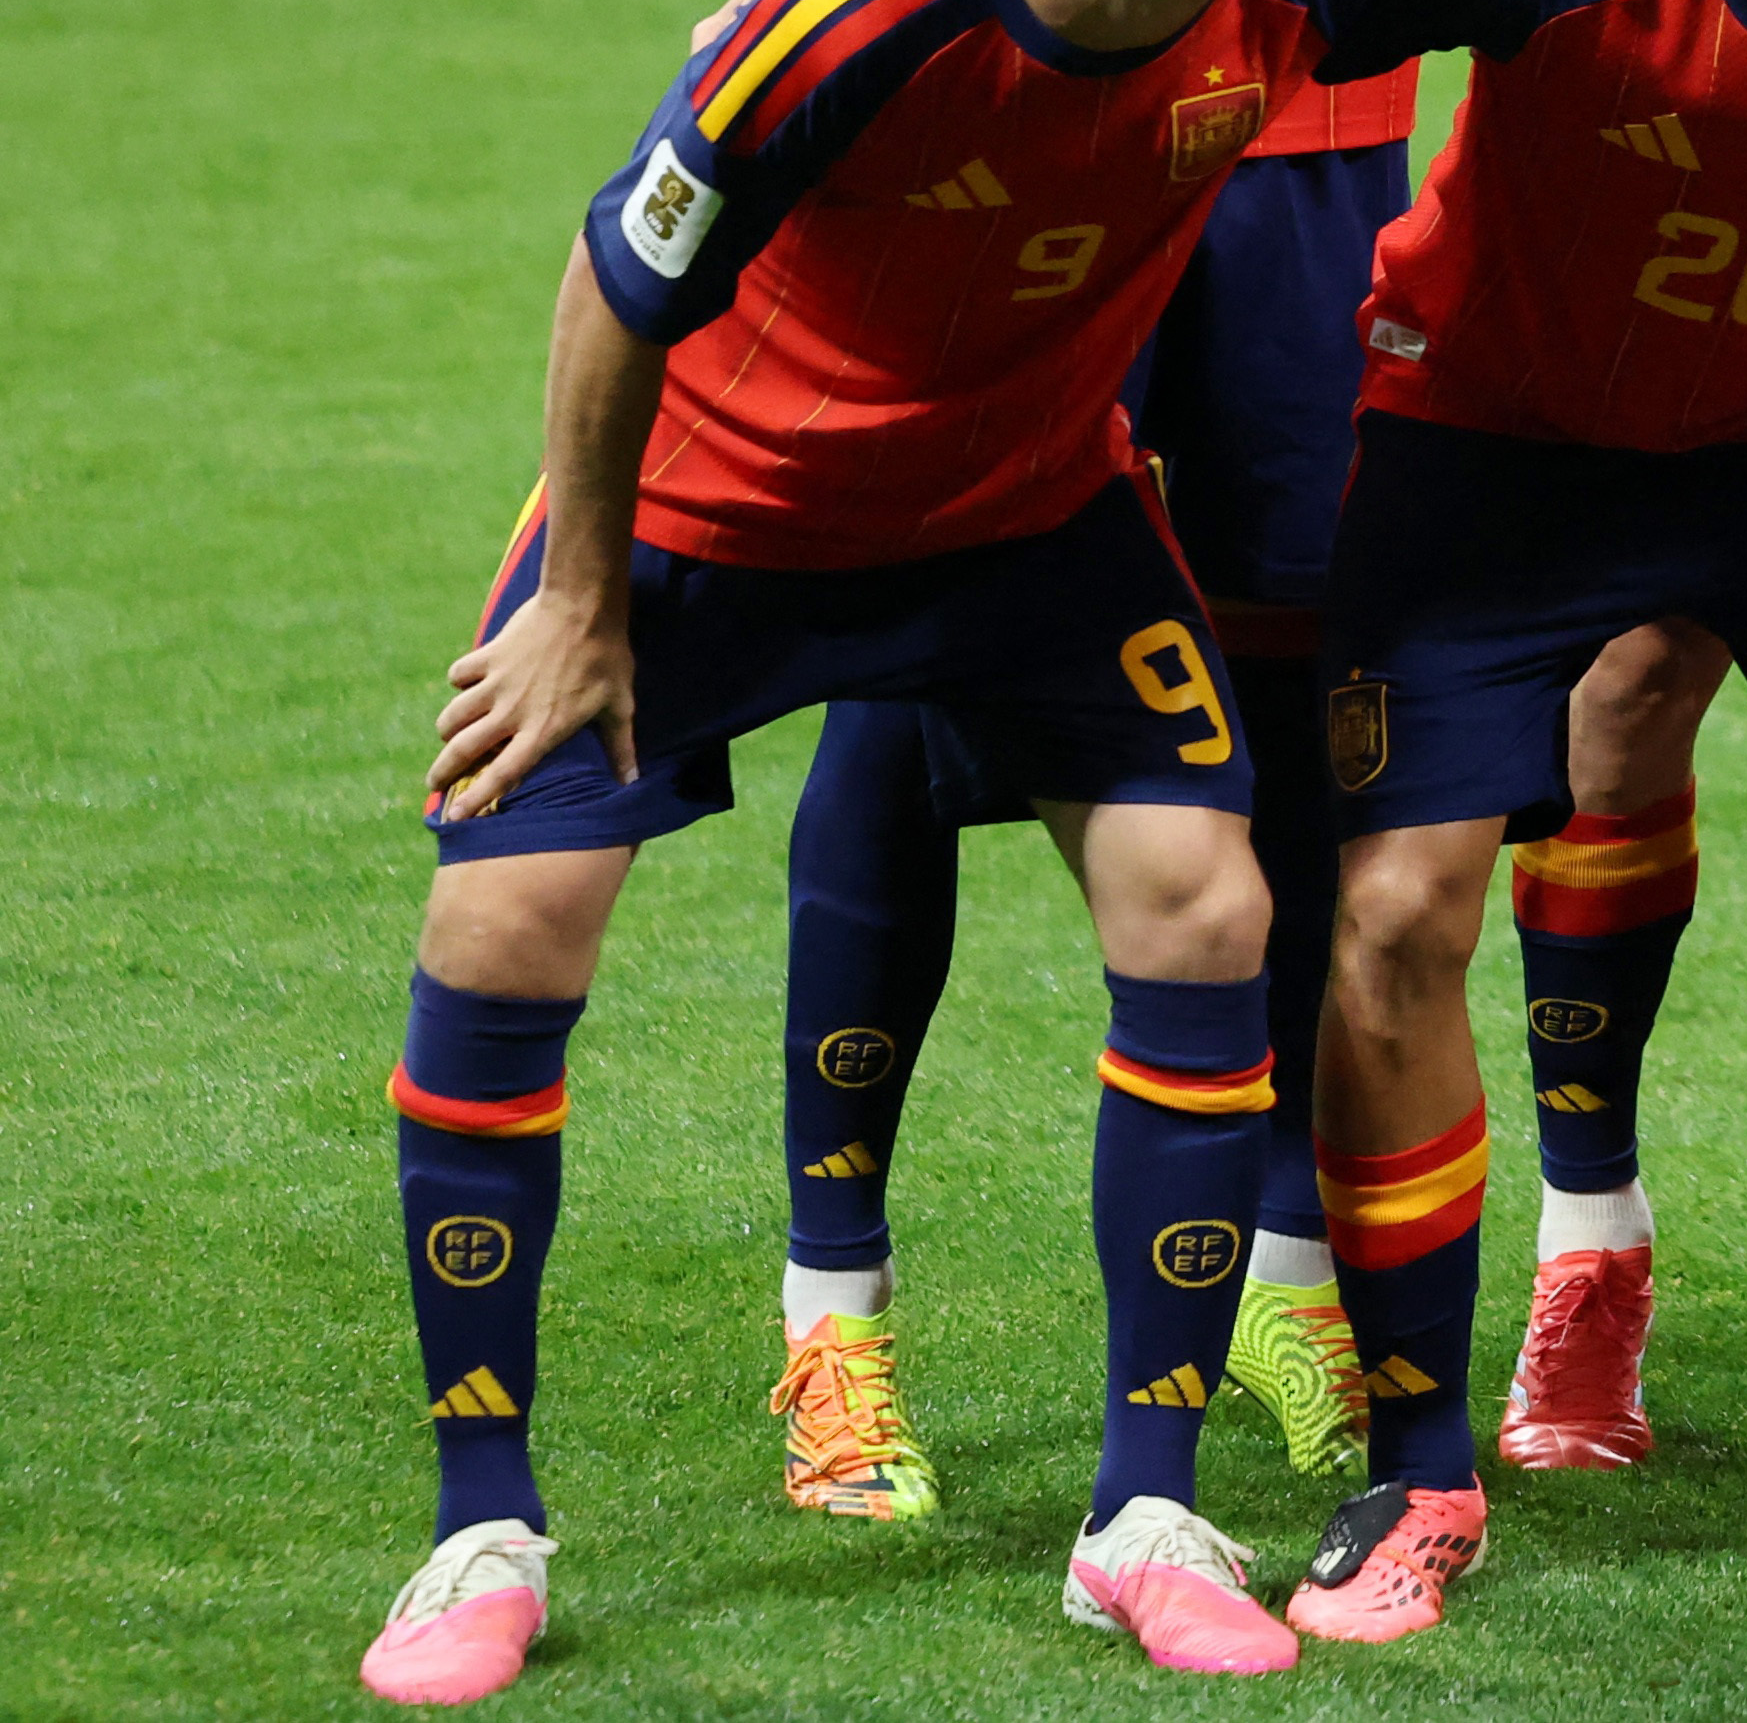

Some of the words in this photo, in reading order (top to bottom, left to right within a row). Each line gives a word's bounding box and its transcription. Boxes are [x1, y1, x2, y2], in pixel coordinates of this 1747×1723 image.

[1010, 225, 1105, 301] 9
[1120, 619, 1231, 765] 9
[836, 1041, 883, 1059] RF
[445, 1229, 493, 1249] RF
[1173, 1233, 1225, 1253] RF
[444, 1250, 493, 1271] EF
[1173, 1253, 1222, 1273] EF
